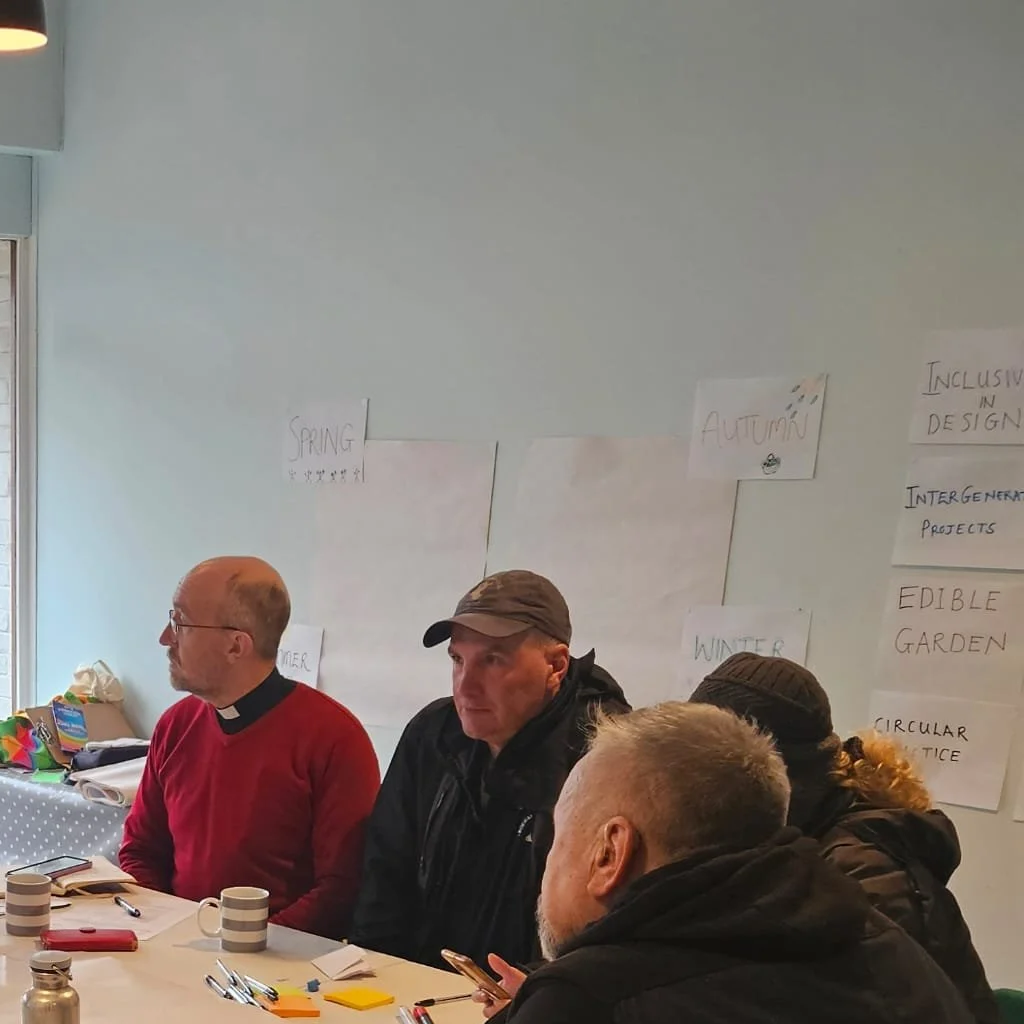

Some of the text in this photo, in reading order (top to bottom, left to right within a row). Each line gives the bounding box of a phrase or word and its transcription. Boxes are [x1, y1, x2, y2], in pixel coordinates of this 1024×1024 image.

[979, 394, 996, 409] IN
[701, 410, 809, 449] AUTUMN
[927, 407, 1022, 435] DESIGN
[288, 415, 354, 462] SPRING
[921, 519, 997, 539] PROJECTS
[898, 585, 1001, 612] EDIBLE
[894, 627, 1007, 655] GARDEN
[873, 717, 969, 742] CIRCULAR
